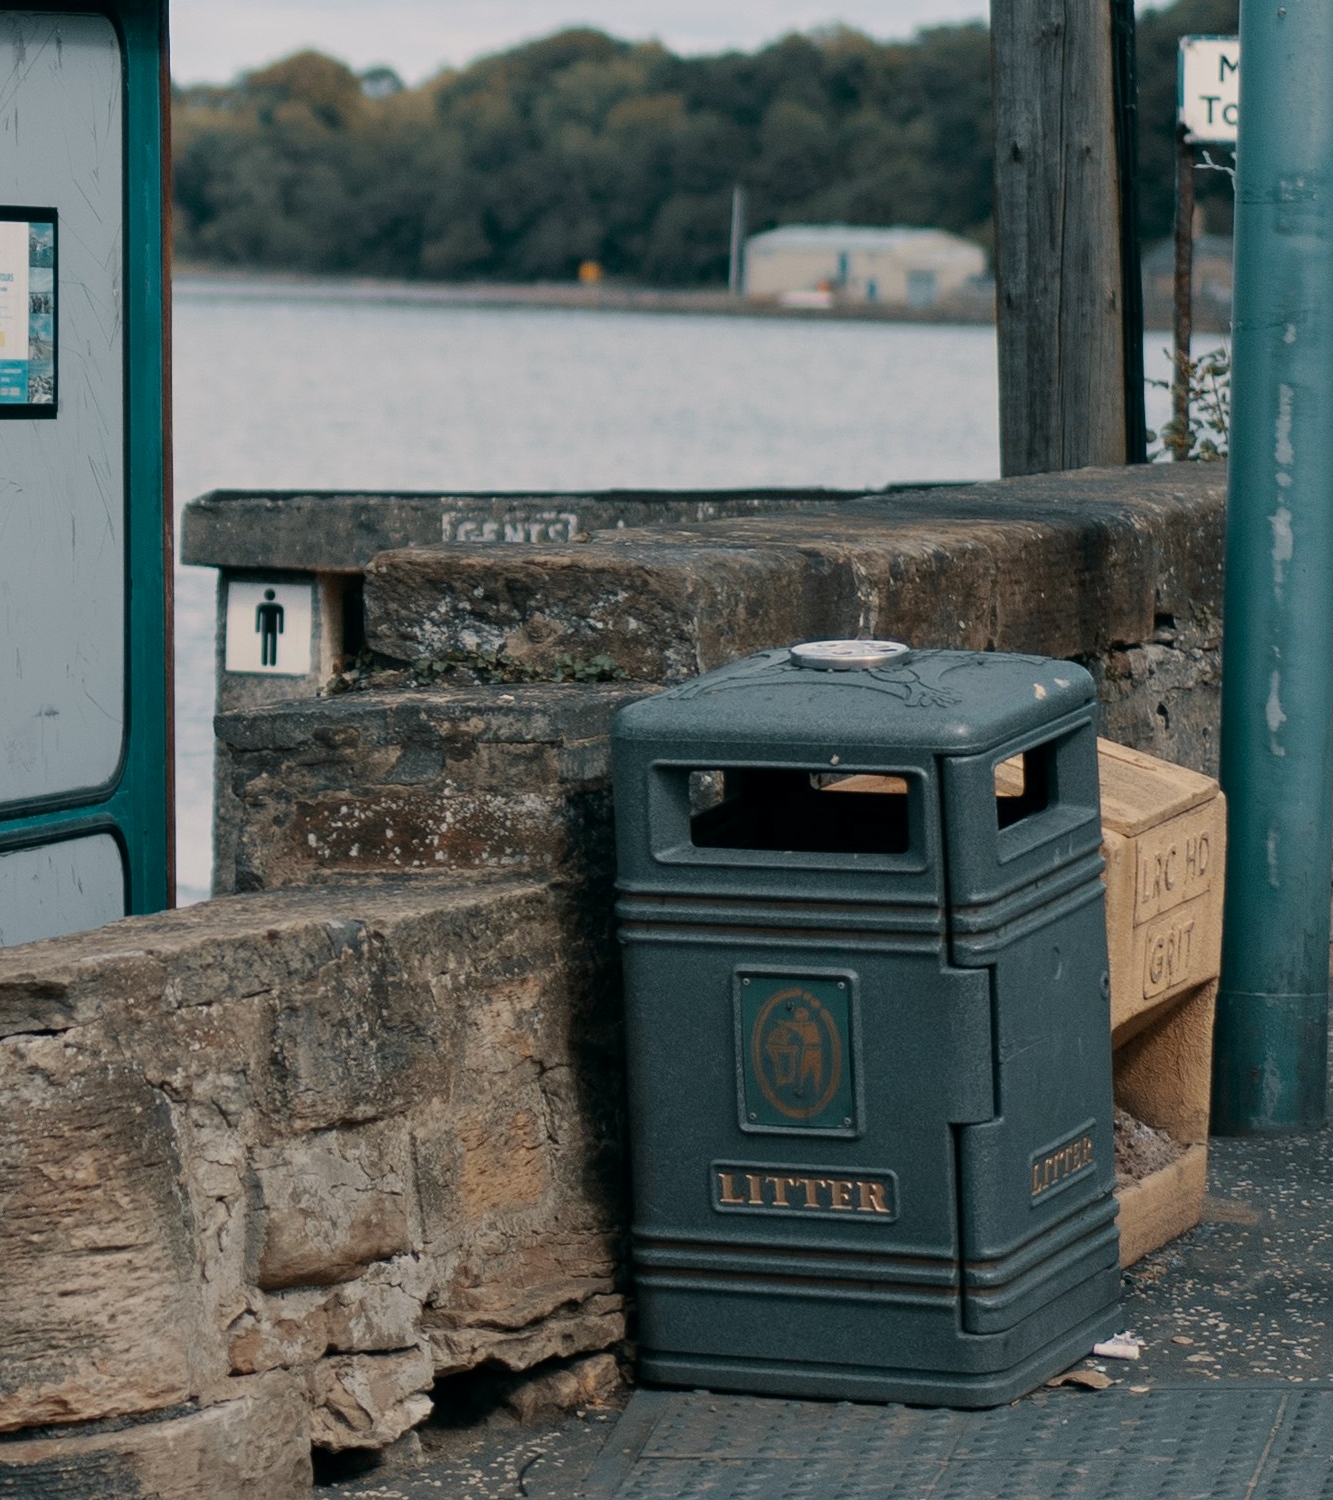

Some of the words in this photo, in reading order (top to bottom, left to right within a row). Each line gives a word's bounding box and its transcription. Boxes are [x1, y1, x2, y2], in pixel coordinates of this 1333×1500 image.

[1149, 918, 1195, 985] GRIT
[718, 1172, 891, 1213] LITTER
[1031, 1136, 1093, 1196] LITTER
